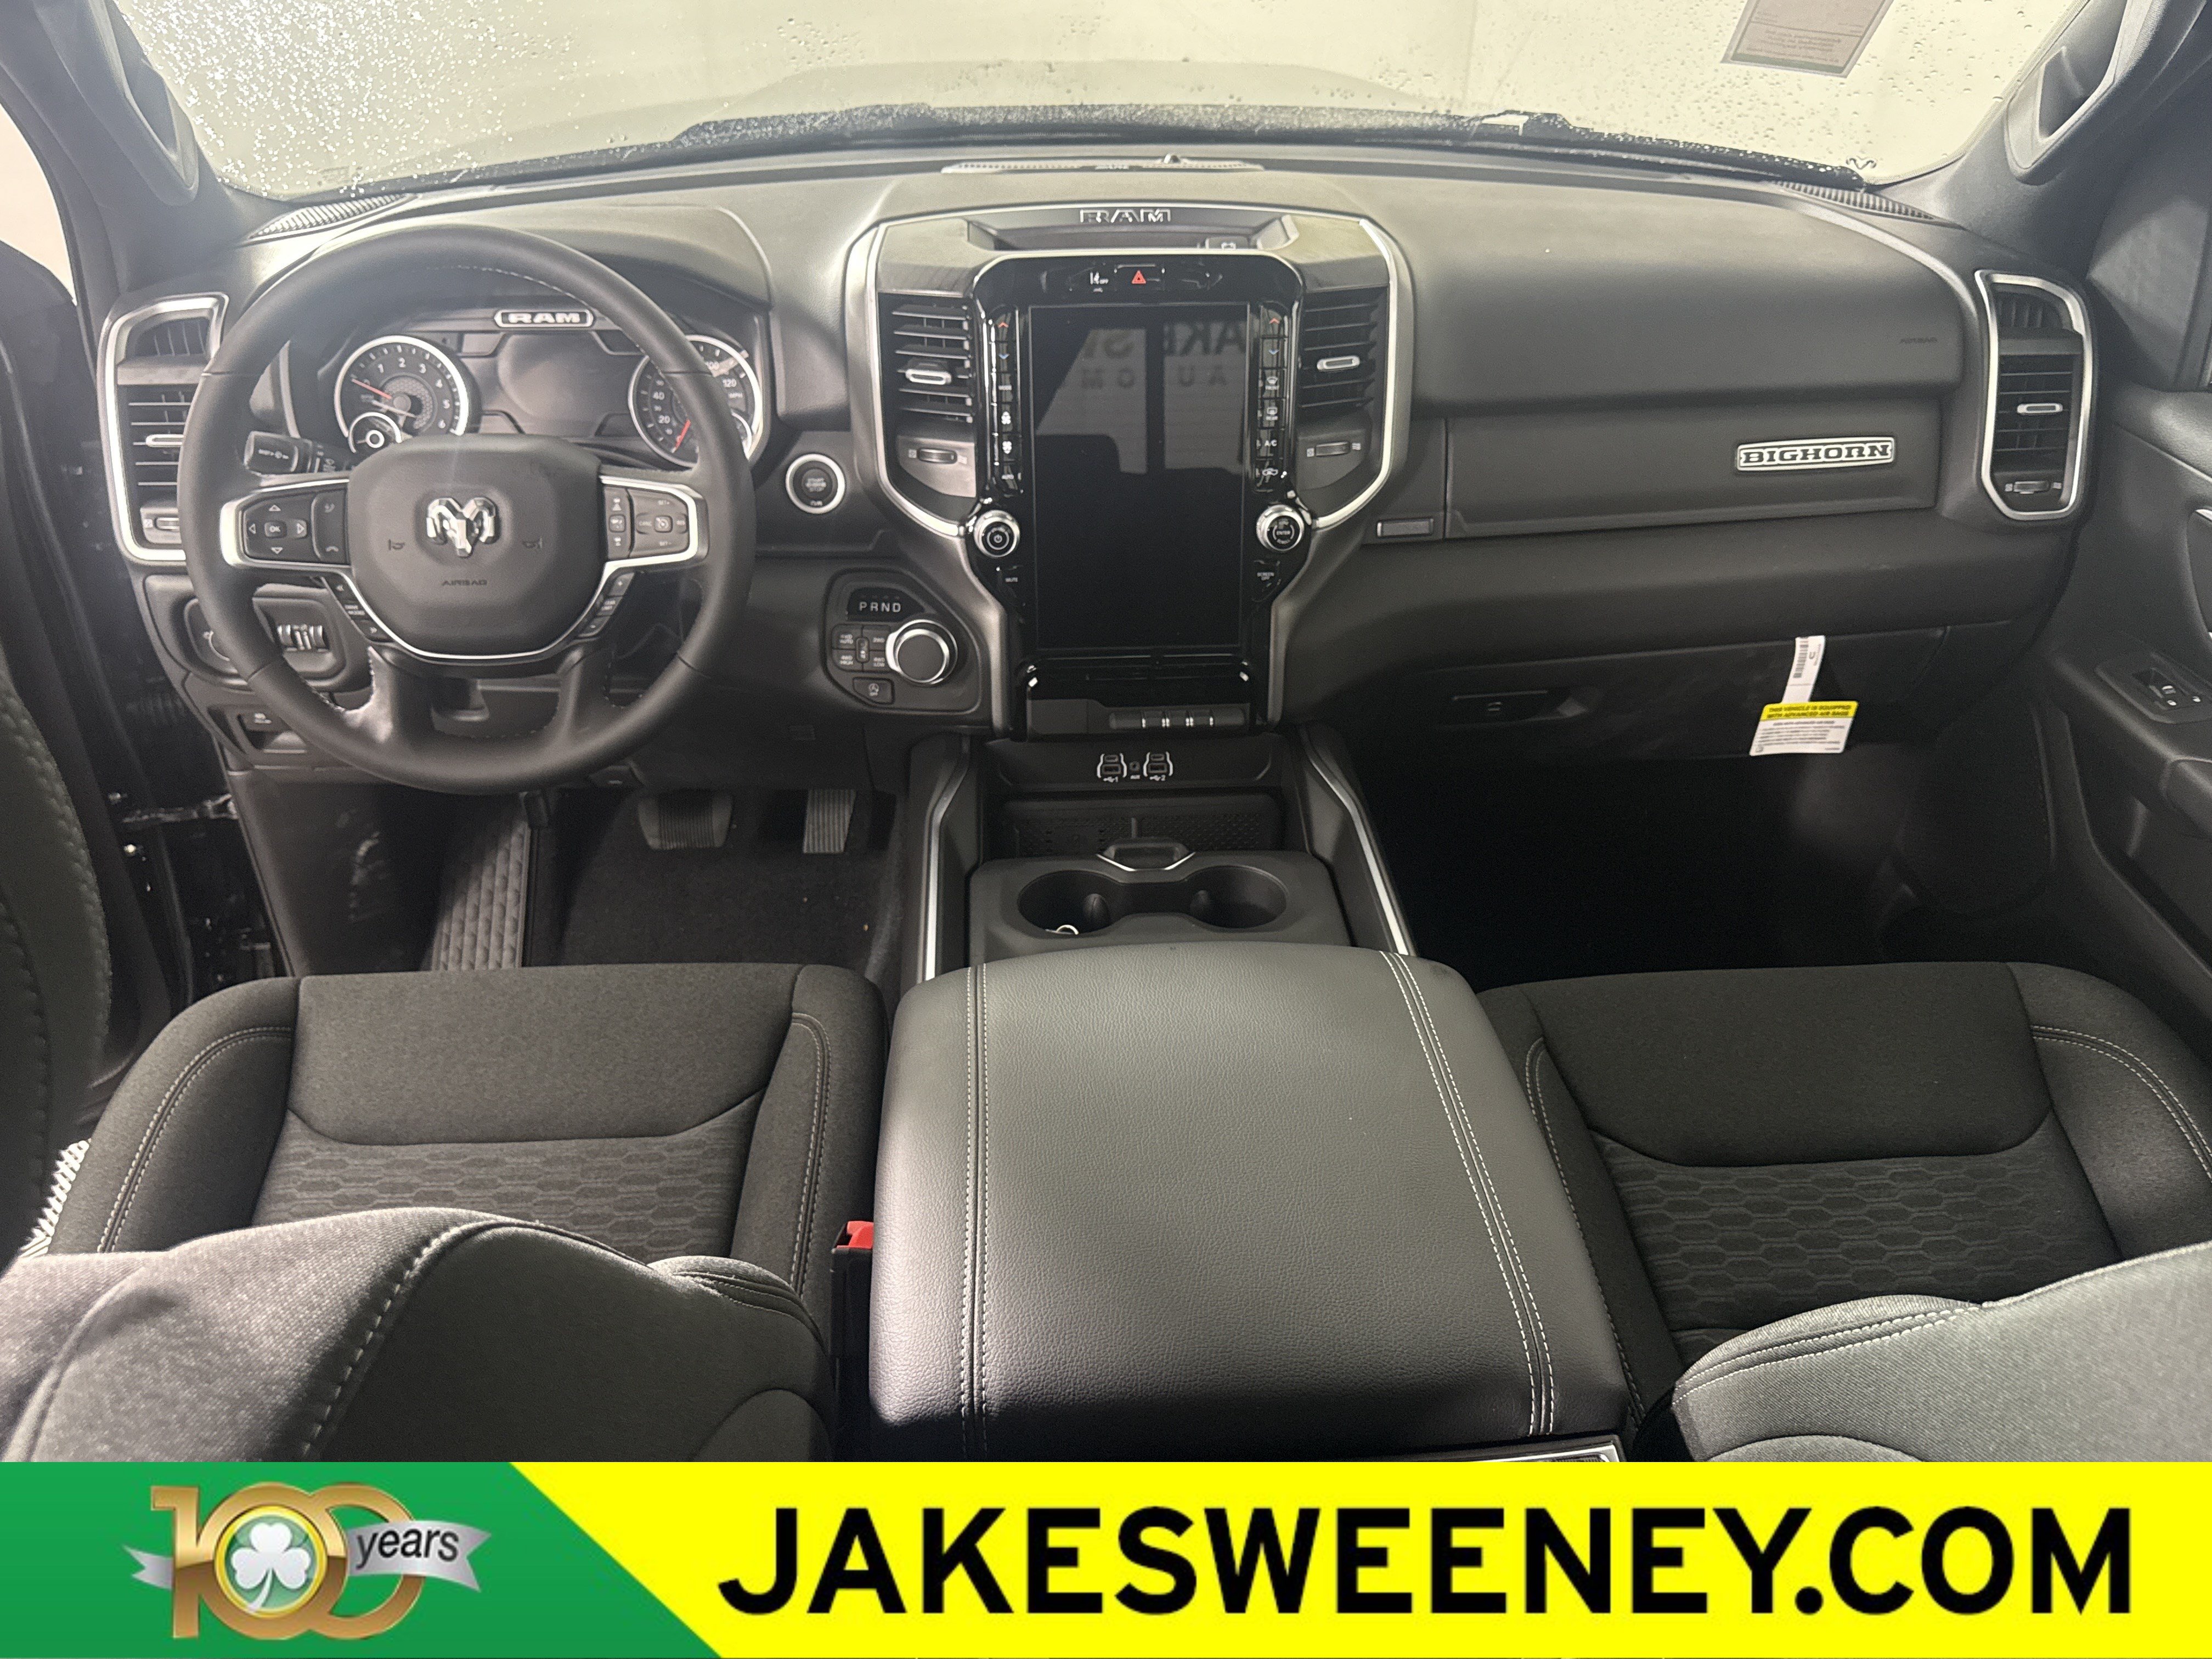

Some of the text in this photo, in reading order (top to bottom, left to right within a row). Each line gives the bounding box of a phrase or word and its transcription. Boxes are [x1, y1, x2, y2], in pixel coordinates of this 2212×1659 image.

[1079, 208, 1171, 223] RAM
[508, 313, 580, 323] RAM
[398, 357, 406, 368] 2
[377, 364, 384, 373] 1
[419, 363, 426, 374] 3
[722, 379, 737, 388] 120
[658, 414, 670, 424] 20
[1743, 445, 1891, 464] BIGHORN
[269, 525, 281, 533] OK
